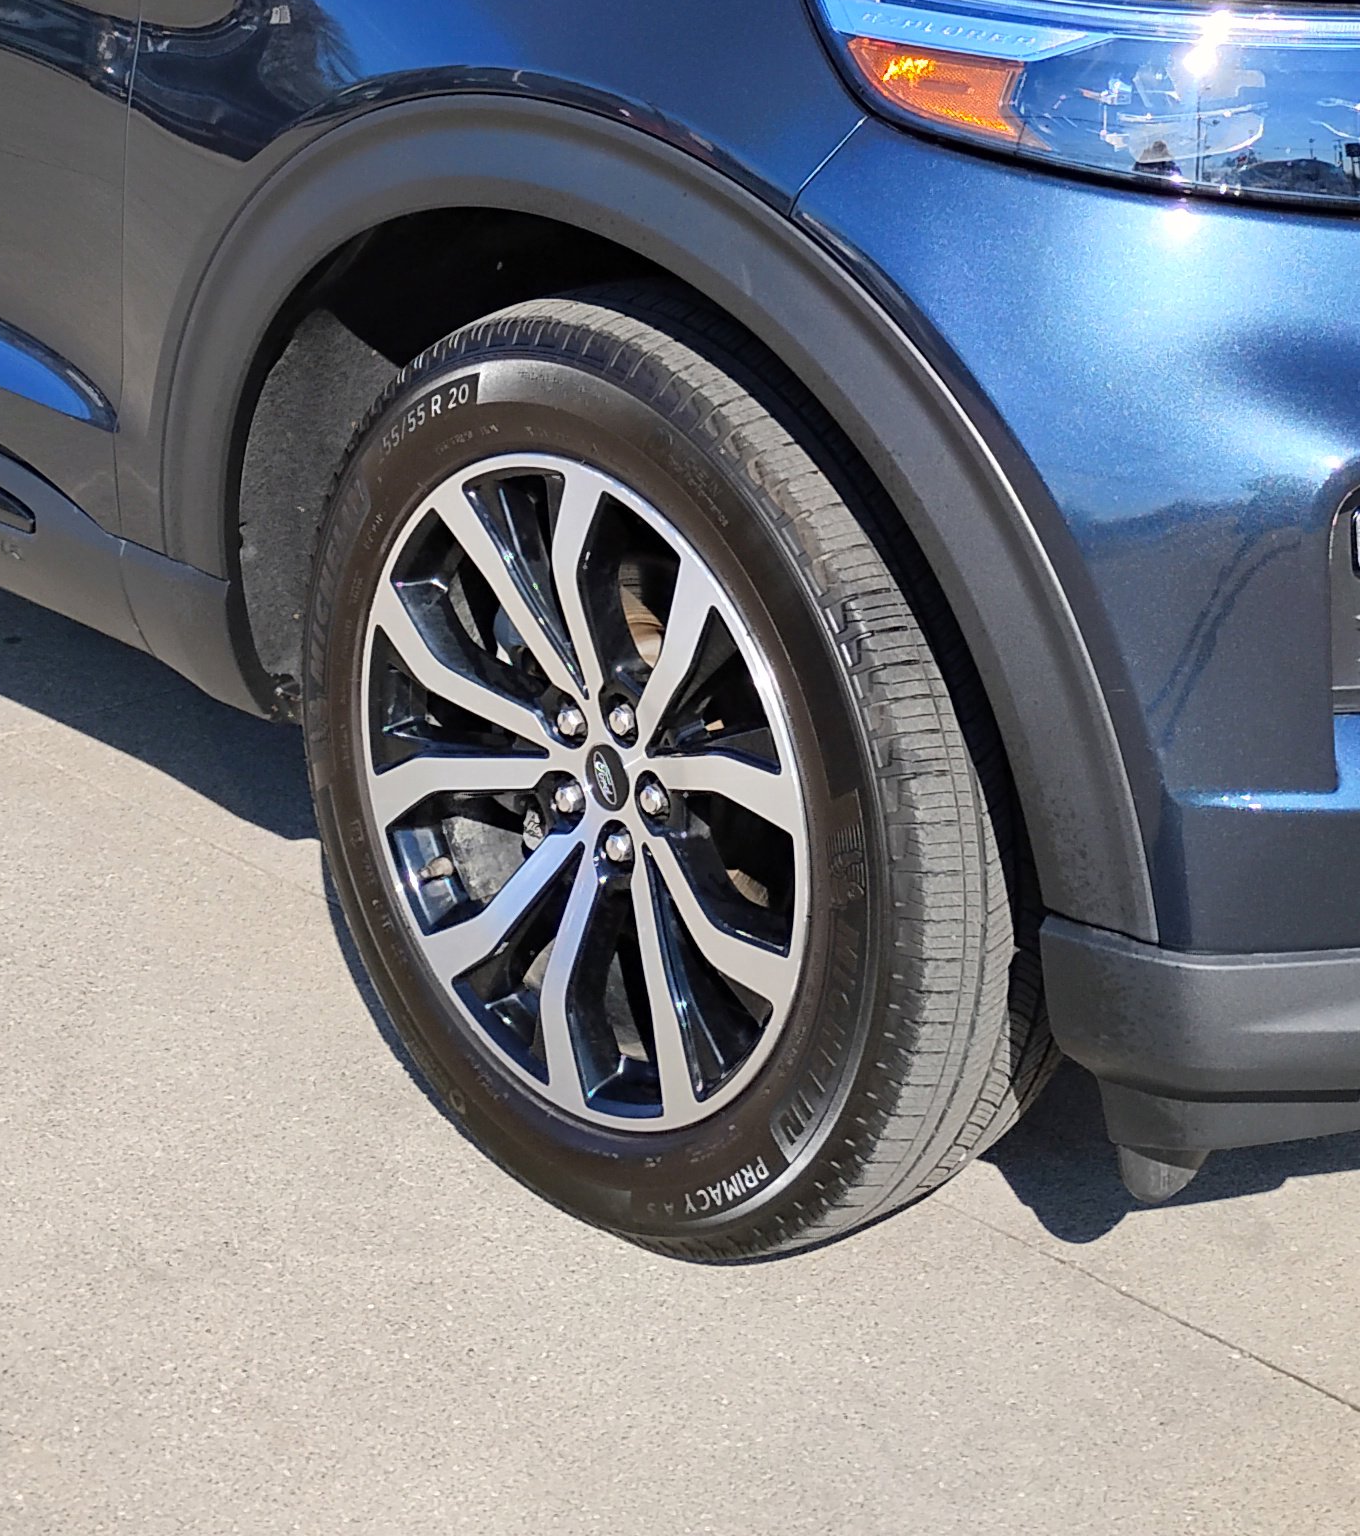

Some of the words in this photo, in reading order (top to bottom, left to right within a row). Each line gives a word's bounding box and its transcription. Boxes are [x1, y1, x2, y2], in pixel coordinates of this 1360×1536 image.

[430, 393, 442, 418] R
[447, 383, 470, 410] 20
[683, 1154, 771, 1215] PRIMACY
